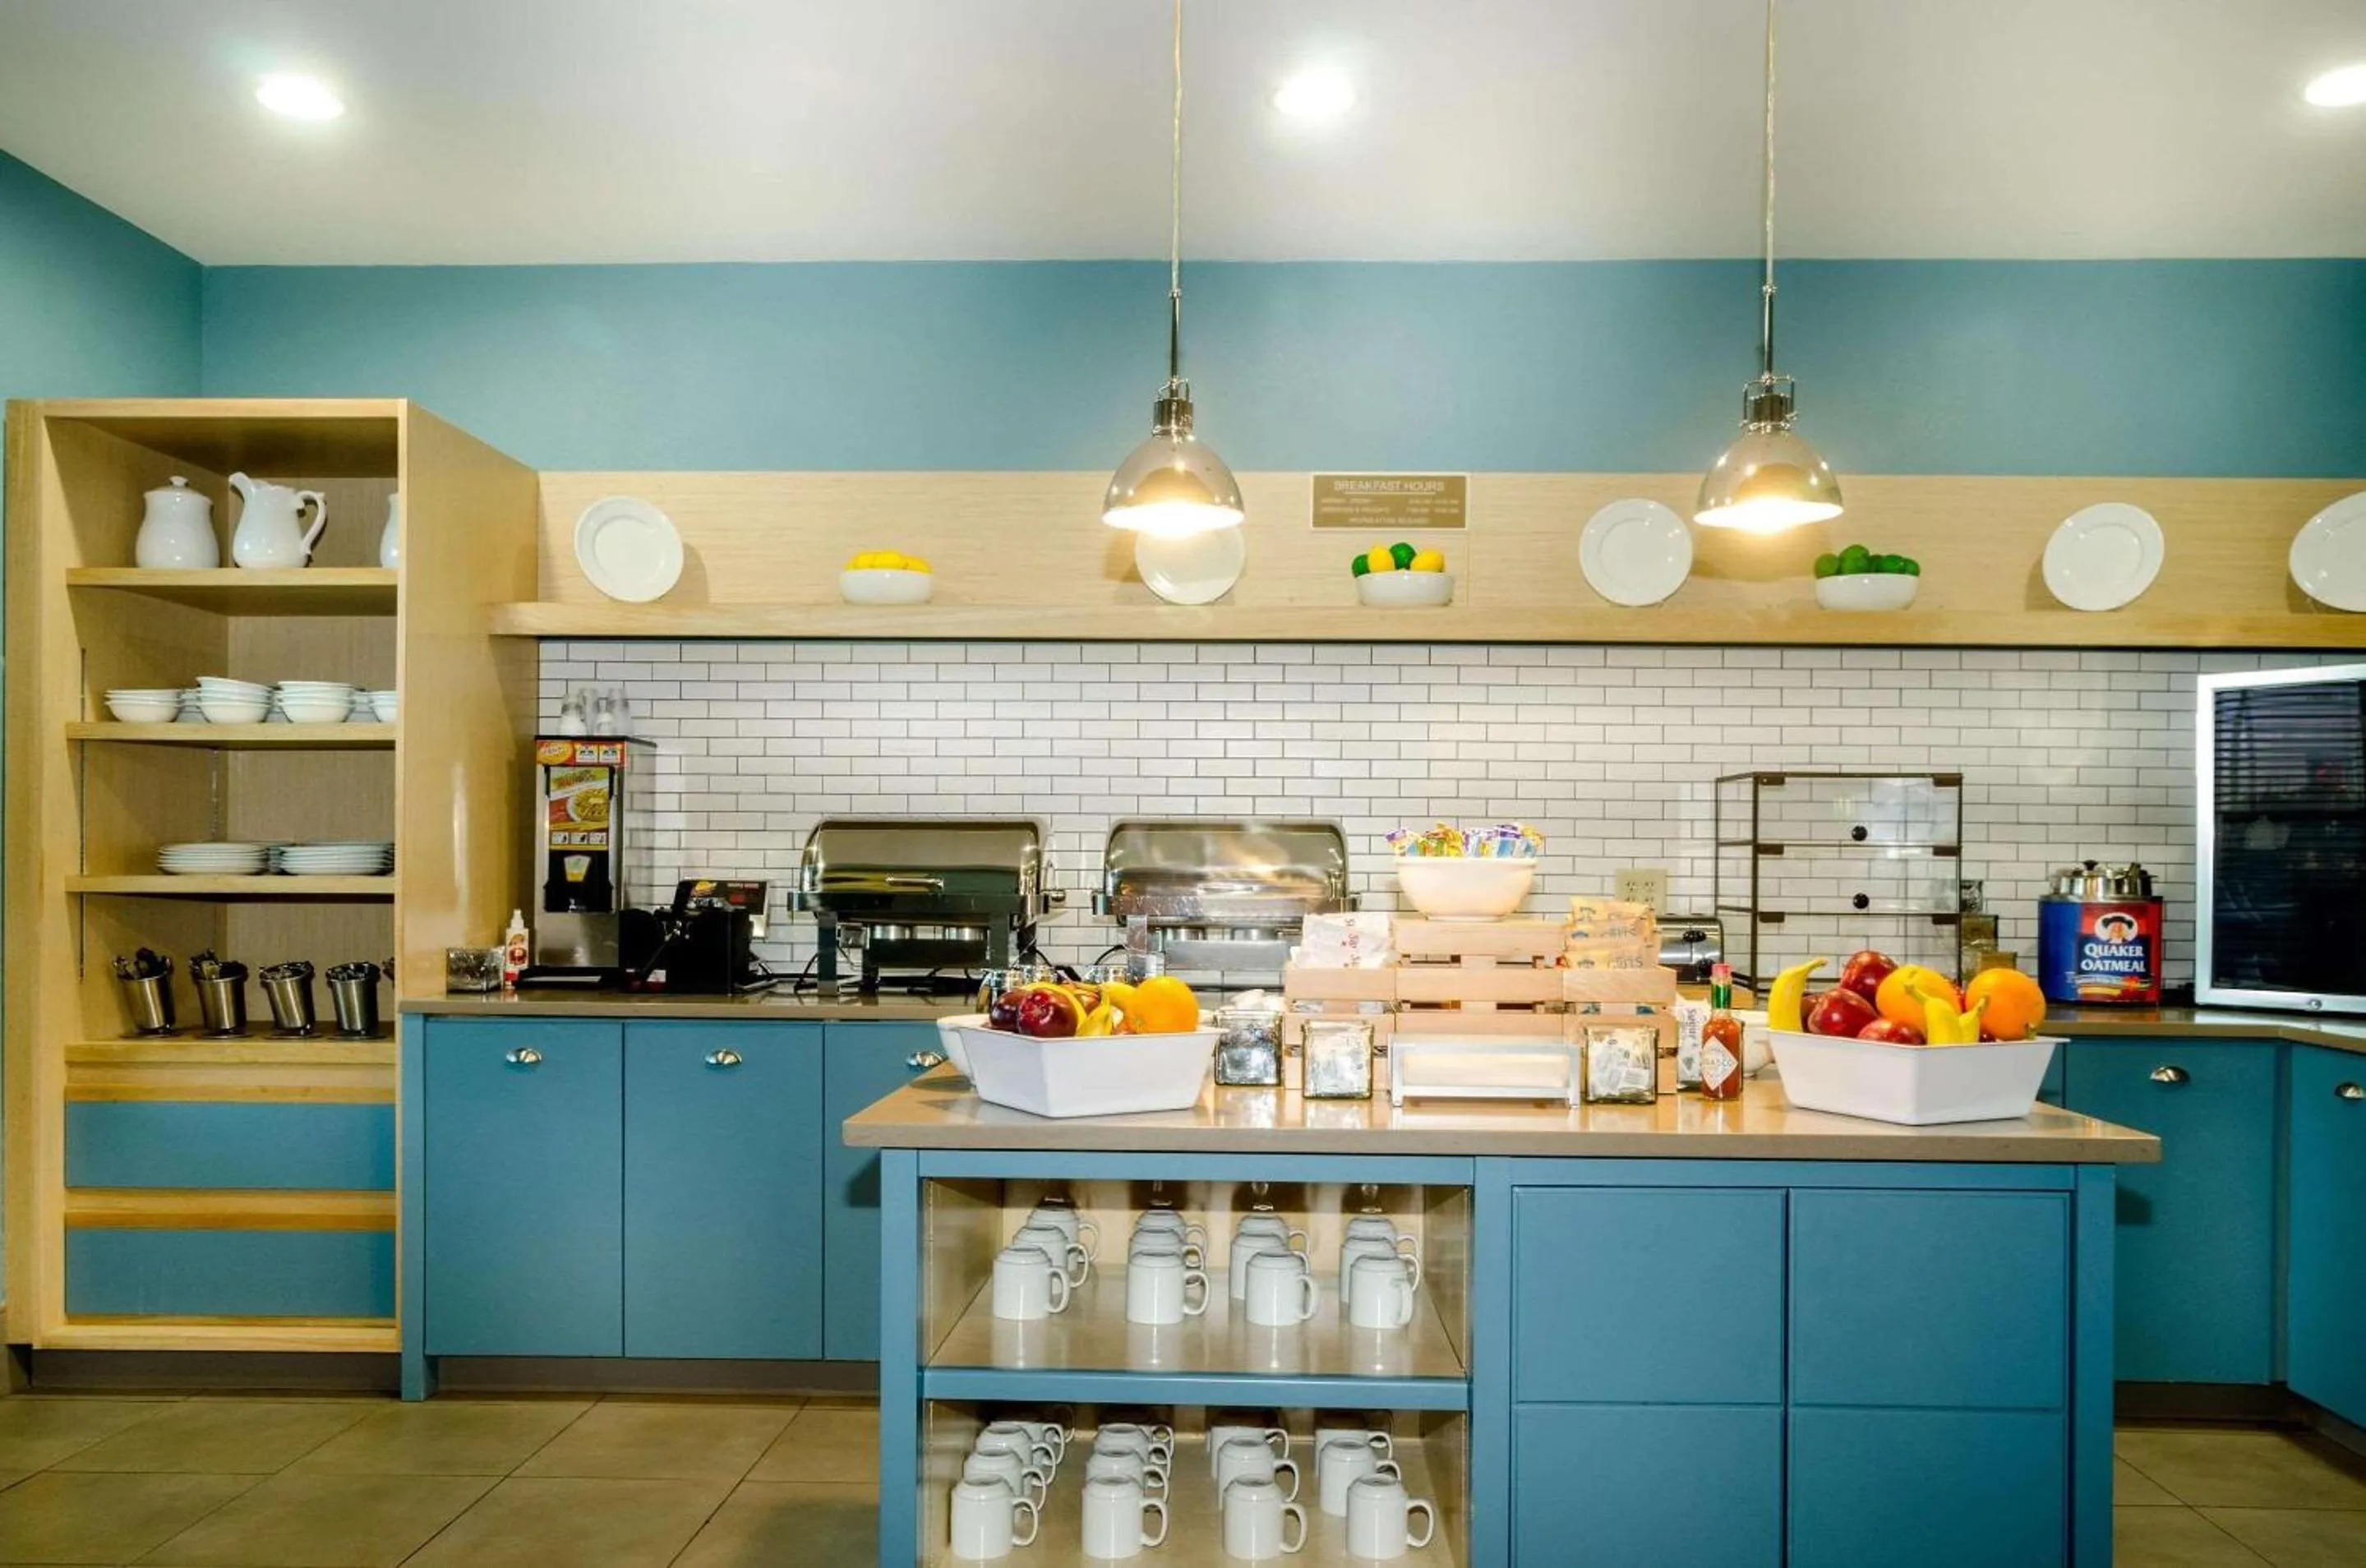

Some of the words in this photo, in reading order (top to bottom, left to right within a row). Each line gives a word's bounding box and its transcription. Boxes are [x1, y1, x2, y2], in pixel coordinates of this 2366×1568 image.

[1334, 480, 1401, 492] BREAKFAST
[1404, 481, 1445, 492] HOURS
[2083, 943, 2144, 958] QUAKER
[2080, 959, 2146, 972] OATMEAL
